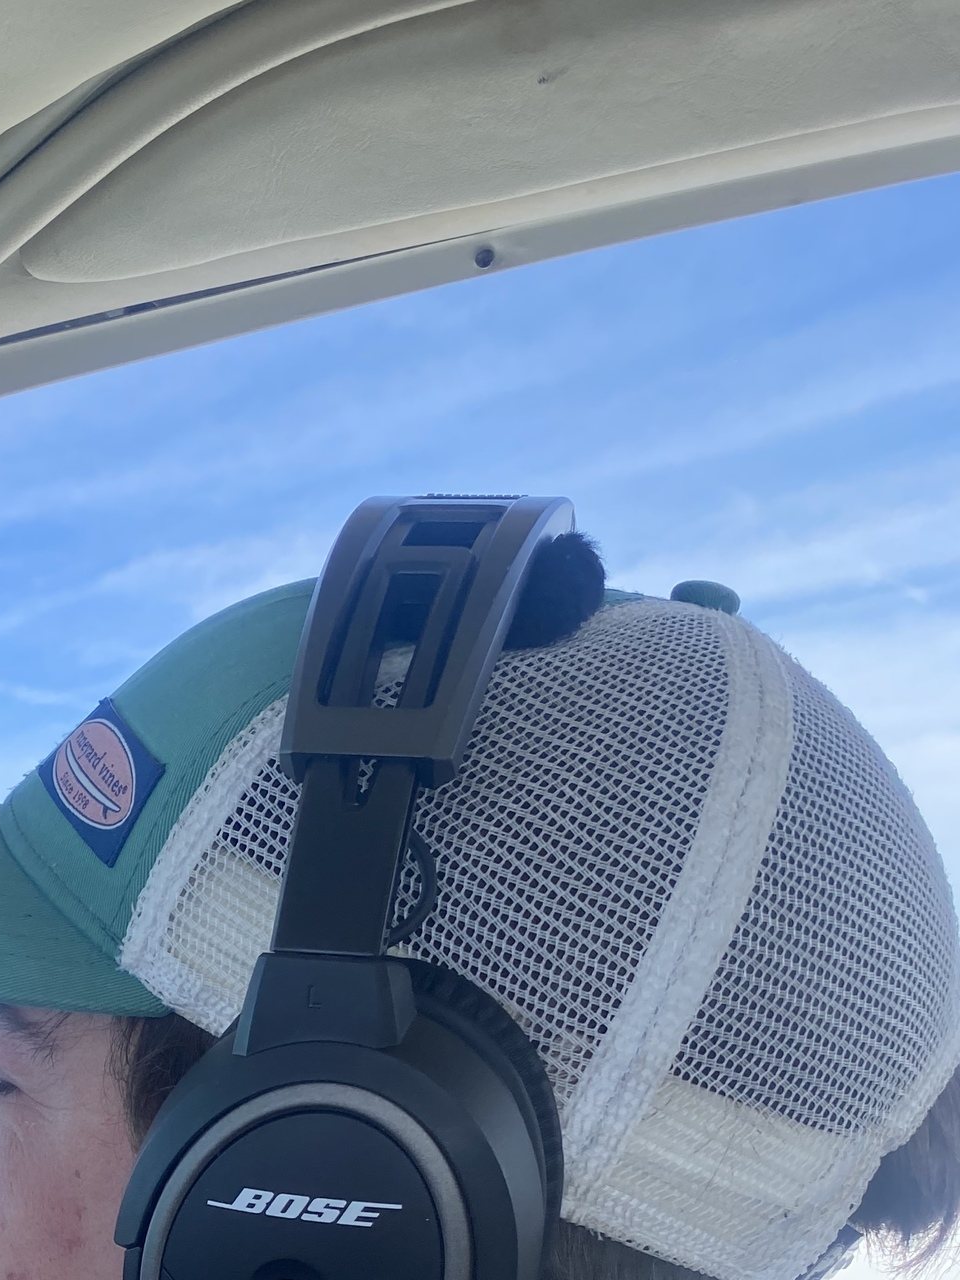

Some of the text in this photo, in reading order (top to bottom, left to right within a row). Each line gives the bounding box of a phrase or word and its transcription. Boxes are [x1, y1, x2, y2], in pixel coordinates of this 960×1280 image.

[75, 729, 107, 770] vineyard
[73, 789, 90, 810] 1998
[207, 1187, 402, 1227] BOSE
